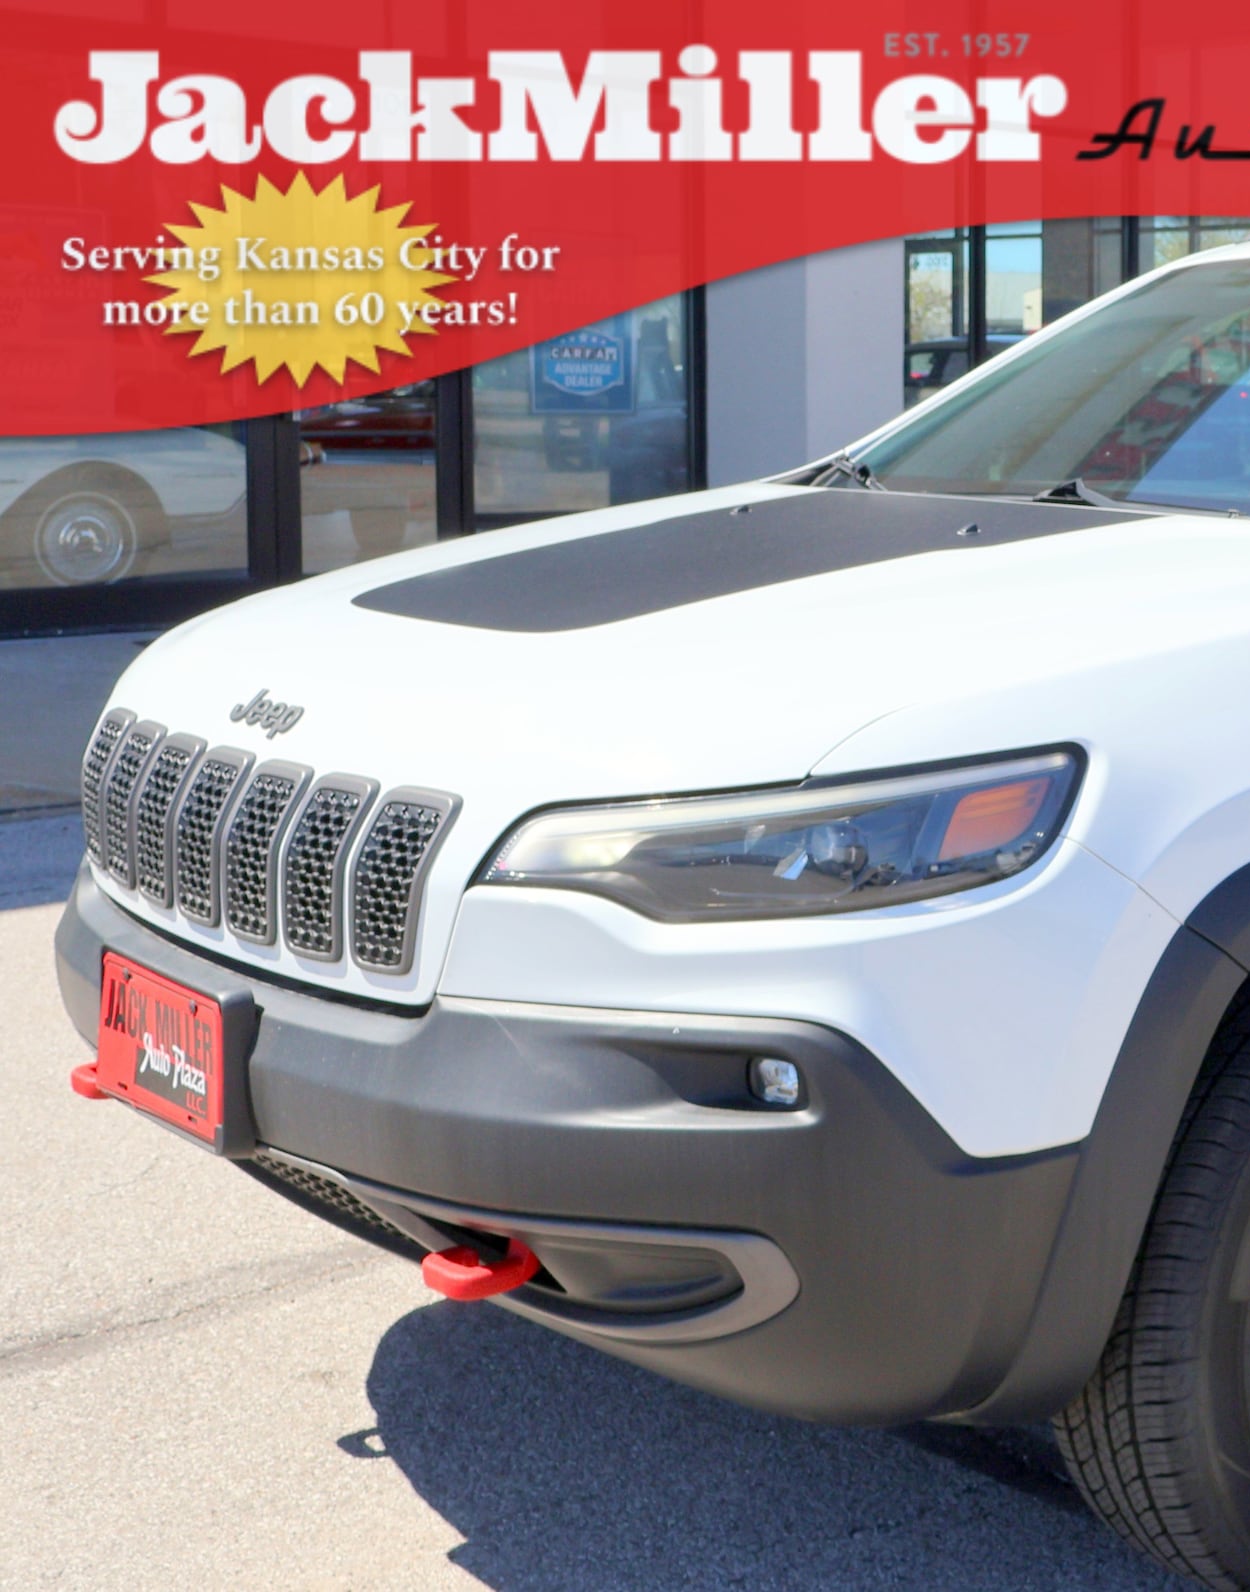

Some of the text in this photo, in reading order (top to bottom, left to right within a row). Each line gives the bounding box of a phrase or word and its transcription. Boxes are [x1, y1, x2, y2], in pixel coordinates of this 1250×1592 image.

[229, 687, 305, 740] Jeep
[105, 979, 213, 1077] JACK MILLER
[139, 1031, 206, 1096] Auto Plaza
[186, 1091, 206, 1114] LLC
